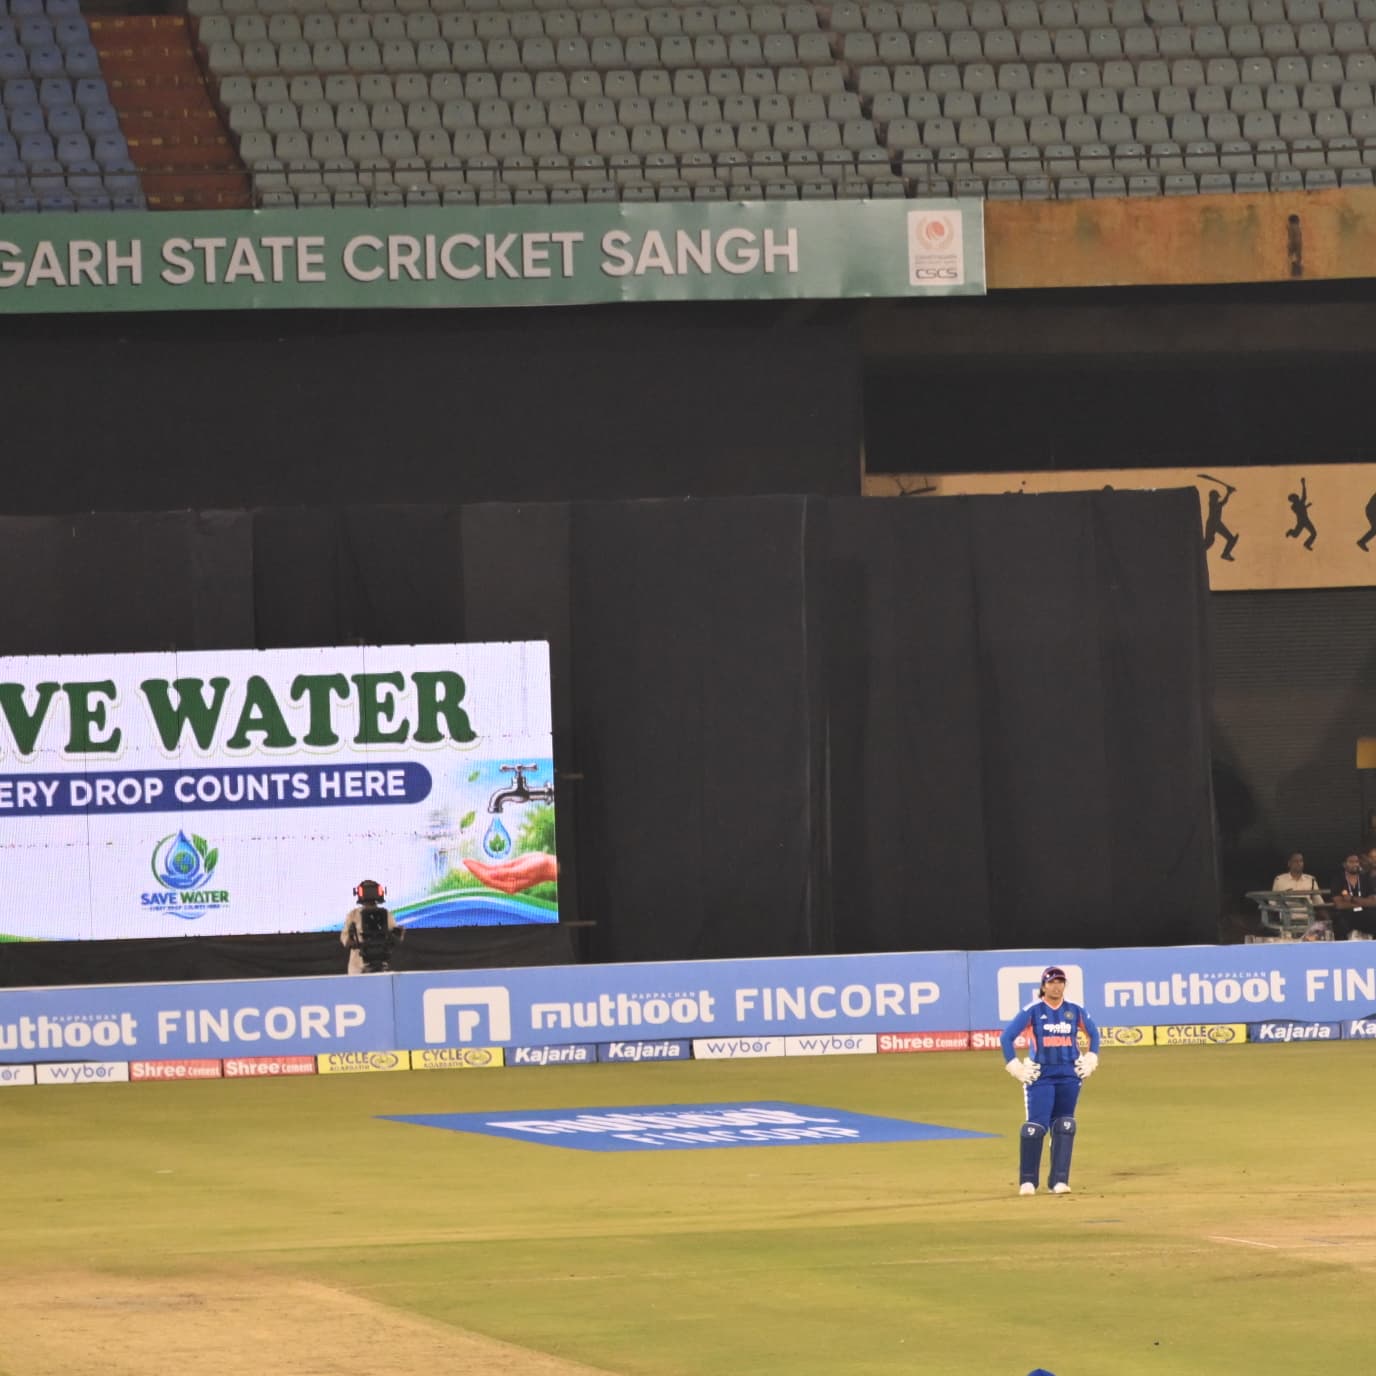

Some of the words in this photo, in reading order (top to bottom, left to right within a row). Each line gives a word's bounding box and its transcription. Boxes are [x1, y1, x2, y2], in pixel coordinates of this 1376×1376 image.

[0, 236, 142, 287] GARH
[161, 233, 326, 285] STATE
[343, 230, 584, 282] CRICKET
[600, 228, 799, 277] SANGH
[141, 670, 477, 752] WATER
[70, 777, 163, 806] DROP
[174, 772, 310, 802] COUNTS
[320, 768, 406, 798] HERE
[141, 892, 177, 906] SAVE
[181, 890, 229, 904] WATER
[1104, 969, 1287, 1009] muthoot
[531, 990, 716, 1029] muthoot
[735, 981, 941, 1023] FINCORP
[158, 1004, 367, 1045] FINCORP
[1167, 1026, 1207, 1038] CYCLE
[1259, 1023, 1331, 1042] Kajaria
[608, 1041, 681, 1061] Kajaria
[880, 1035, 934, 1050] Shree
[1043, 1036, 1072, 1047] INDIA
[329, 1053, 369, 1066] CYCLE
[422, 1049, 462, 1062] CYCLE
[515, 1046, 587, 1065] Kajaria
[133, 1062, 186, 1078] Shree
[226, 1060, 280, 1076] Shree
